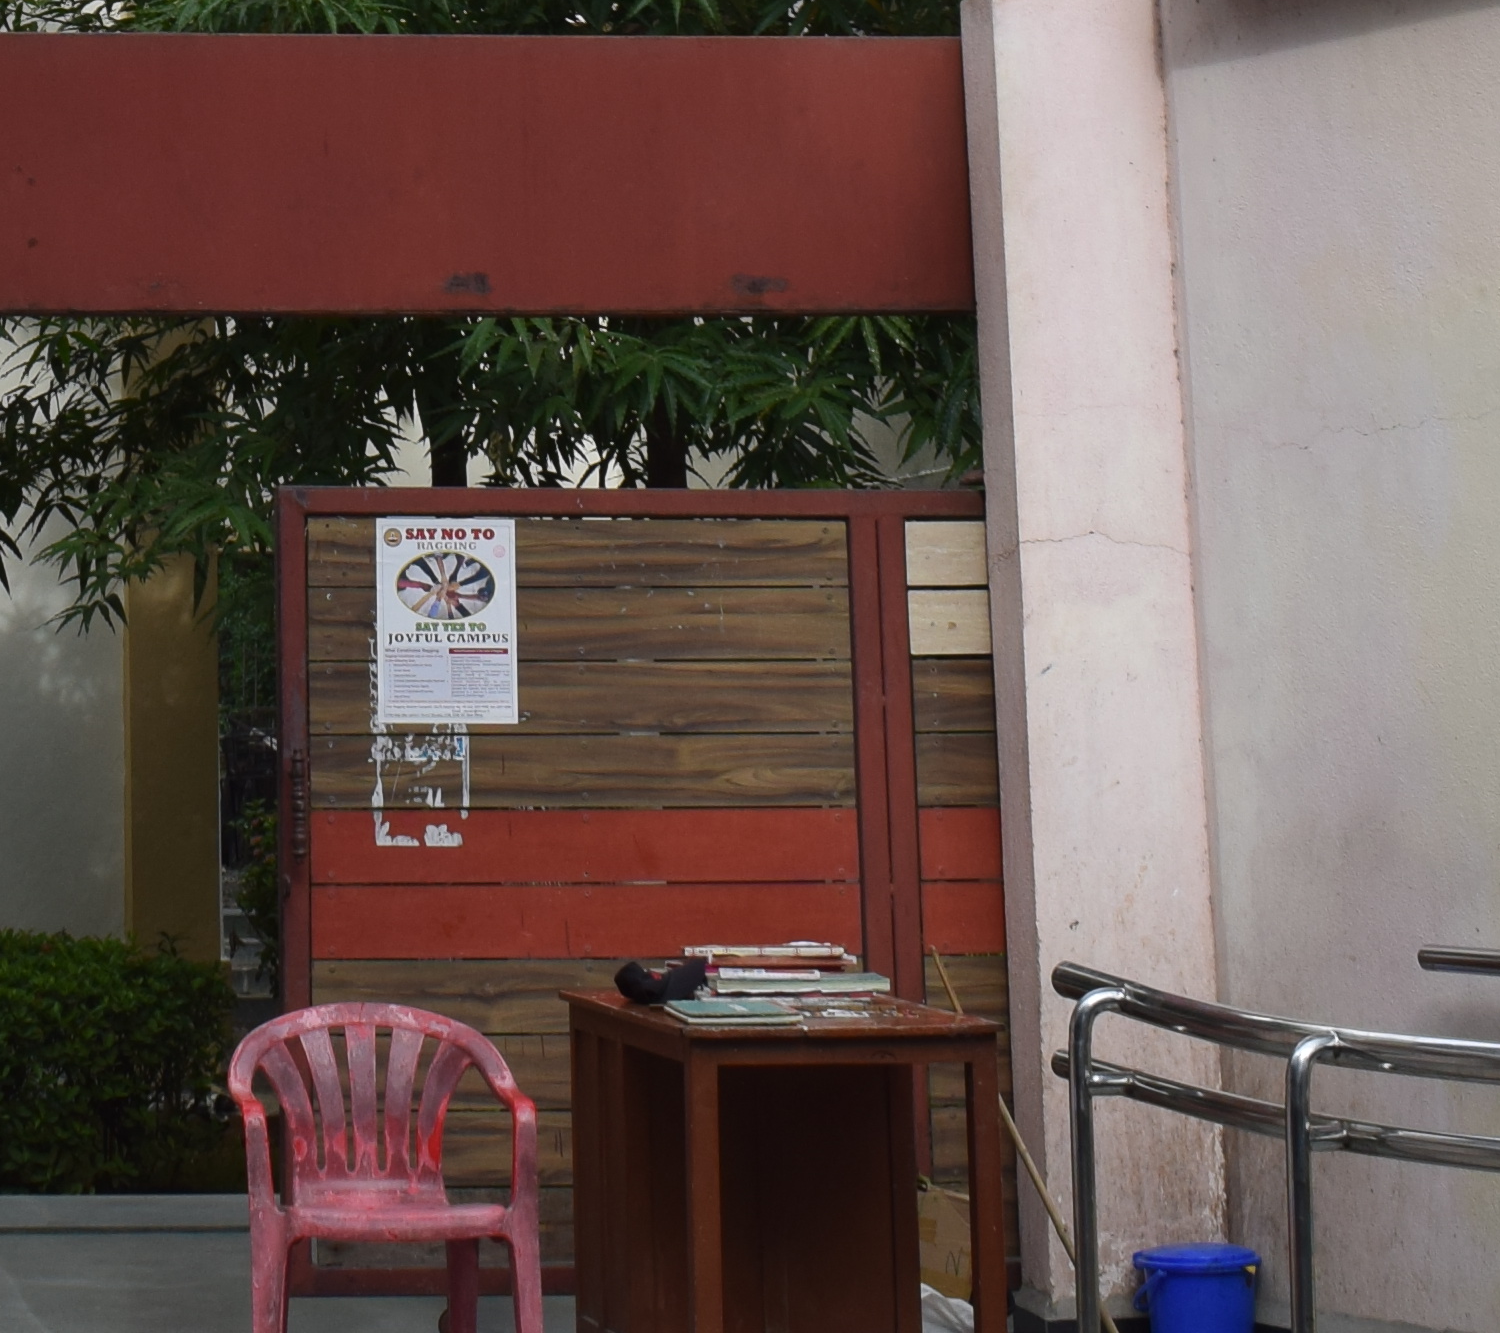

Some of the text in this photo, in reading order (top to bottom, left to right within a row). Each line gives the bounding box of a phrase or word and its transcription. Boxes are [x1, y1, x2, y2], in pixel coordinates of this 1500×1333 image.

[405, 528, 495, 541] SAY NO TO
[416, 541, 477, 551] RAGGING
[415, 622, 487, 632] SAY YES TO
[388, 633, 509, 645] JOYFUL CAMPUS
